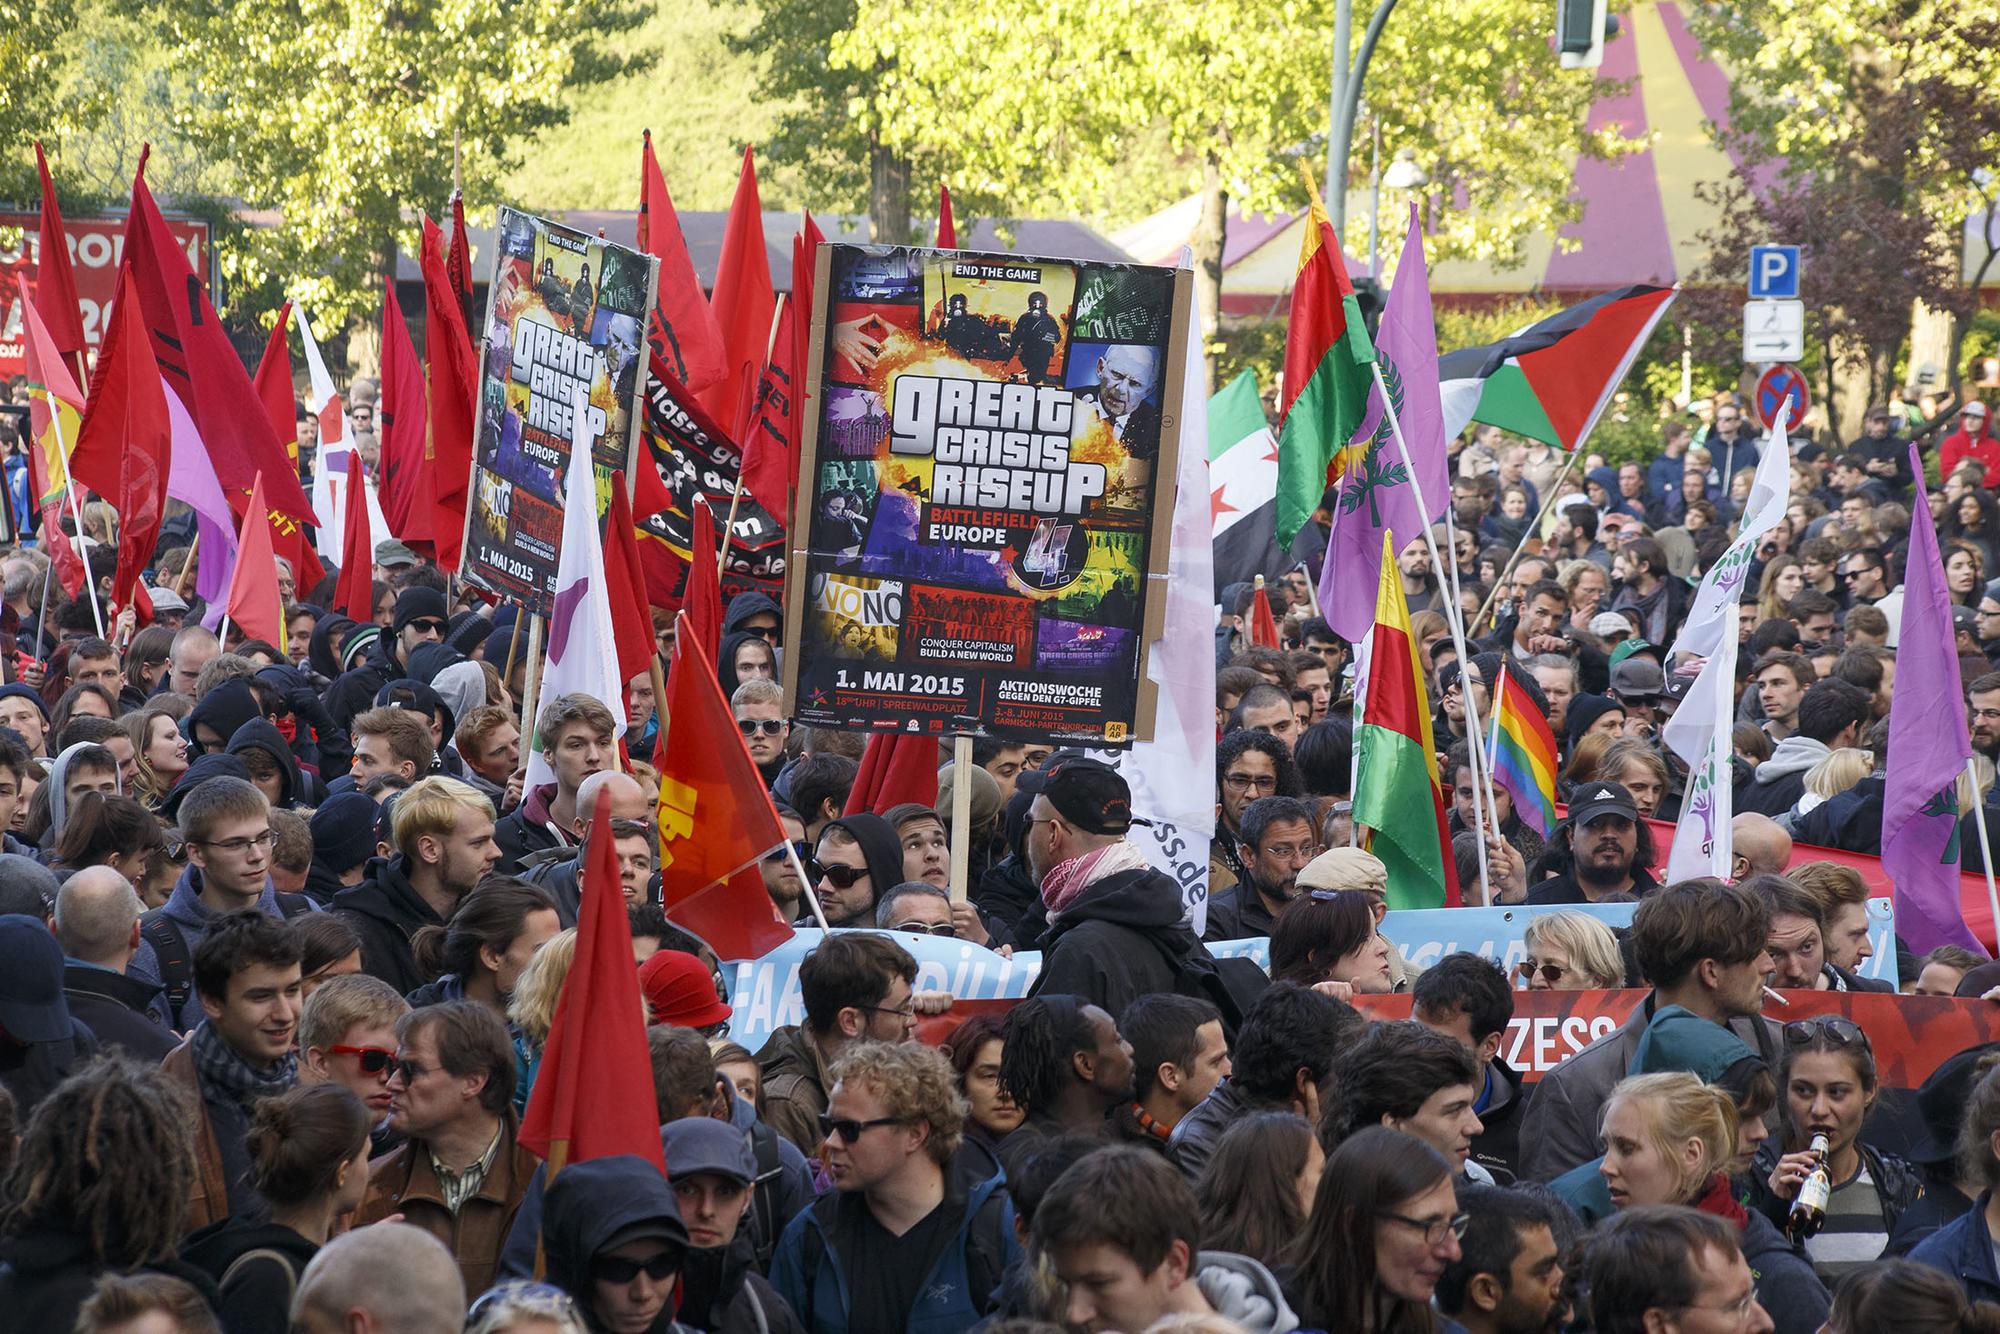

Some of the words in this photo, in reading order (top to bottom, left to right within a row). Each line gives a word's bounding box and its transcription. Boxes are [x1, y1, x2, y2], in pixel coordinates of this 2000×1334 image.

[550, 234, 560, 245] END
[561, 237, 573, 249] THE
[955, 264, 979, 277] END
[982, 266, 1003, 279] THE
[1006, 268, 1037, 281] GAME
[1760, 252, 1788, 291] P
[526, 396, 607, 448] RISEP
[525, 428, 572, 453] BATTLEFIEL
[935, 427, 1069, 471] CRISIS
[524, 441, 560, 465] EUROPE
[932, 462, 1107, 515] RISEUP
[930, 507, 1040, 529] BATTLEFIELD
[929, 524, 1006, 545] EUROPE
[514, 538, 527, 550] BUILD
[539, 549, 555, 561] WORLD
[480, 546, 488, 562] 1.
[490, 550, 508, 571] MAI
[508, 560, 533, 582] 2015
[920, 638, 962, 650] CONQUER
[964, 640, 1014, 653] CAPITALISM
[920, 648, 947, 659] BUILD
[948, 650, 956, 659] A
[958, 650, 978, 661] NEW
[979, 652, 1013, 663] WORLD
[836, 670, 857, 689] 1.
[863, 671, 904, 692] MAI
[909, 675, 965, 696] 2015
[999, 680, 1102, 698] AKTIONSWOCHE
[883, 701, 968, 713] SPREEWALDPLATZ
[998, 690, 1031, 701] GEGEN
[1032, 693, 1052, 703] DEN
[1053, 695, 1102, 707] G7-GIPFEL
[994, 717, 1101, 731] GARMISCH-PARTENKIRCHEN
[1018, 709, 1040, 719] JUNI
[1042, 711, 1064, 721] 2015
[1109, 724, 1122, 732] AR
